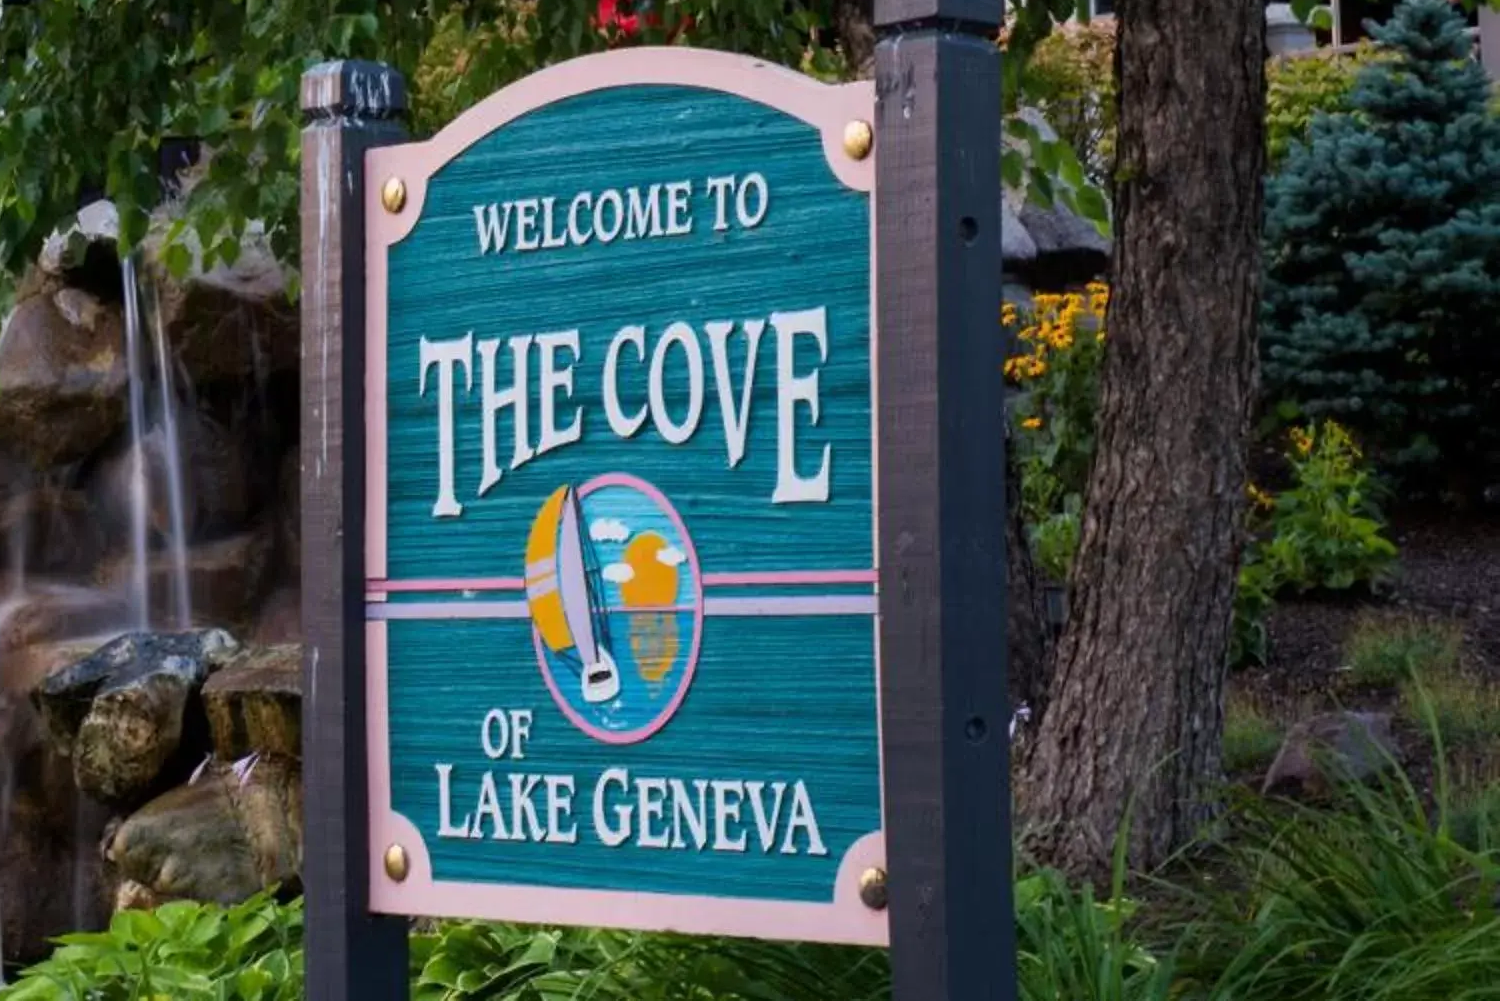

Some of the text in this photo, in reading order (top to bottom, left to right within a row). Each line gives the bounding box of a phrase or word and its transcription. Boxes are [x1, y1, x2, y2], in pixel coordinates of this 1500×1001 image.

[473, 173, 768, 254] WELCOME TO
[418, 306, 831, 516] THE COVE
[481, 708, 532, 759] OF
[434, 764, 827, 855] LAKE GENEVA
